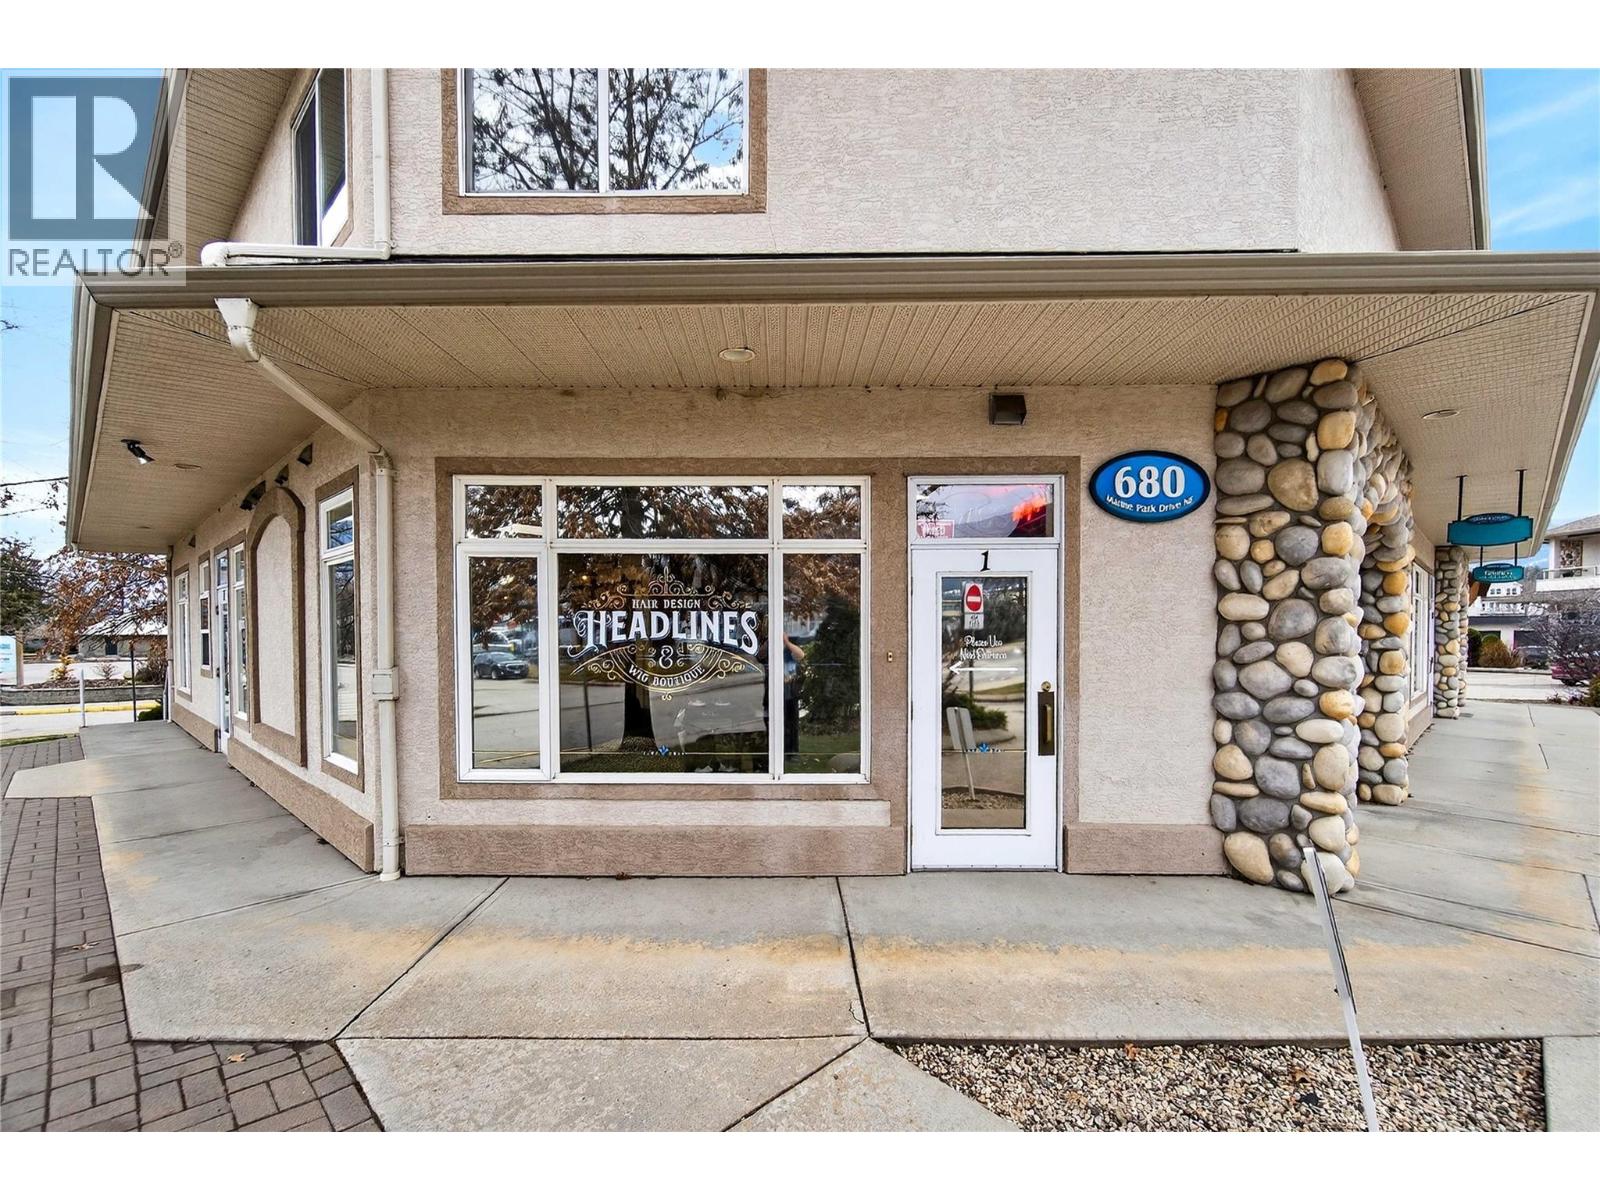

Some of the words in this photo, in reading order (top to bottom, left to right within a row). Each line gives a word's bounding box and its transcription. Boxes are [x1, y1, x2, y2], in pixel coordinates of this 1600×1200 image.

[1114, 465, 1186, 499] 680
[1136, 503, 1157, 513] Park
[1159, 502, 1181, 513] Drive
[980, 550, 992, 572] 1
[632, 599, 659, 609] HAIR
[663, 599, 701, 609] DESIGN
[567, 610, 759, 658] HEADLINES
[628, 664, 649, 683] WIG
[652, 666, 705, 687] BOUTIQUE
